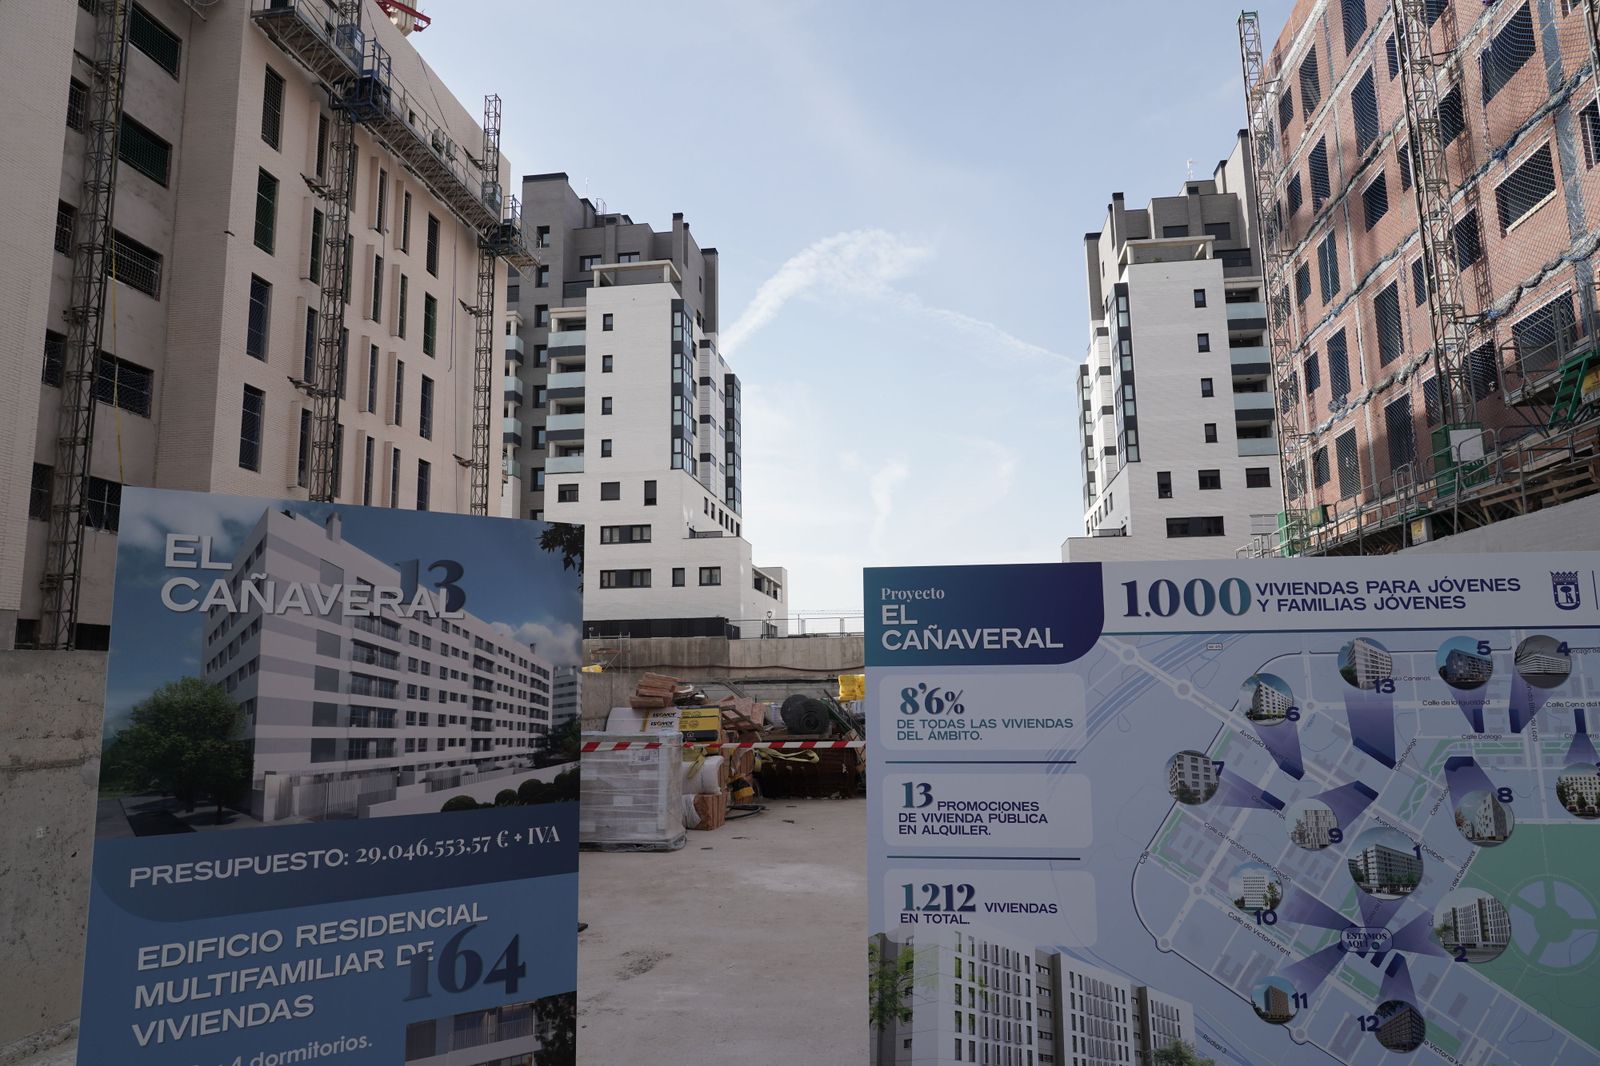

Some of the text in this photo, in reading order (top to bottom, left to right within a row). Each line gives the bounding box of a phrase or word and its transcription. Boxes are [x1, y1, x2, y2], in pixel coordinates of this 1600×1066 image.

[164, 532, 232, 570] EL
[394, 558, 467, 613] 13
[1256, 576, 1521, 596] VIVIENDAS PARA JÓVENES
[160, 573, 465, 620] CAÑAVERAL
[880, 587, 945, 602] Proyecto
[1121, 577, 1251, 618] 1.000
[1256, 594, 1467, 612] Y FAMILIAS JÓVENES
[881, 605, 918, 625] EL
[881, 625, 1064, 650] CAÑAVERAL
[1476, 640, 1492, 655] 5
[1556, 641, 1572, 657] 4
[1374, 678, 1396, 693] 13
[1286, 707, 1300, 721] 6
[896, 718, 1074, 729] DE TODAS LAS VIVIENDAS
[896, 728, 983, 741] DEL ÁMBITO.
[1212, 761, 1224, 776] 7
[902, 781, 1040, 812] 13 PROMOCIONES
[1497, 787, 1514, 803] 8
[898, 810, 1048, 824] DE VIVIENDA PÚBLICA
[898, 825, 991, 838] EN ALQUILER.
[1328, 828, 1344, 844] 9
[130, 848, 350, 888] PRESUPUESTO:
[355, 833, 492, 866] 29.046.553,57
[496, 829, 509, 850] €
[527, 825, 561, 847] IVA
[1412, 845, 1422, 861] 1
[900, 882, 1058, 914] 1.212 VIVIENDAS
[900, 913, 970, 925] EN TOTAL.
[1254, 909, 1278, 926] 10
[137, 902, 488, 972] EDIFICIO RESIDENCIAL
[1346, 932, 1388, 940] ESTAMOS
[1455, 946, 1469, 963] 2
[403, 924, 527, 1003] 164
[133, 940, 436, 1010] MULTIFAMILIAR DE
[1291, 992, 1308, 1009] 11
[131, 994, 315, 1047] VIVIENDAS
[1357, 1015, 1381, 1032] 12
[249, 1034, 373, 1066] dormitorios.
